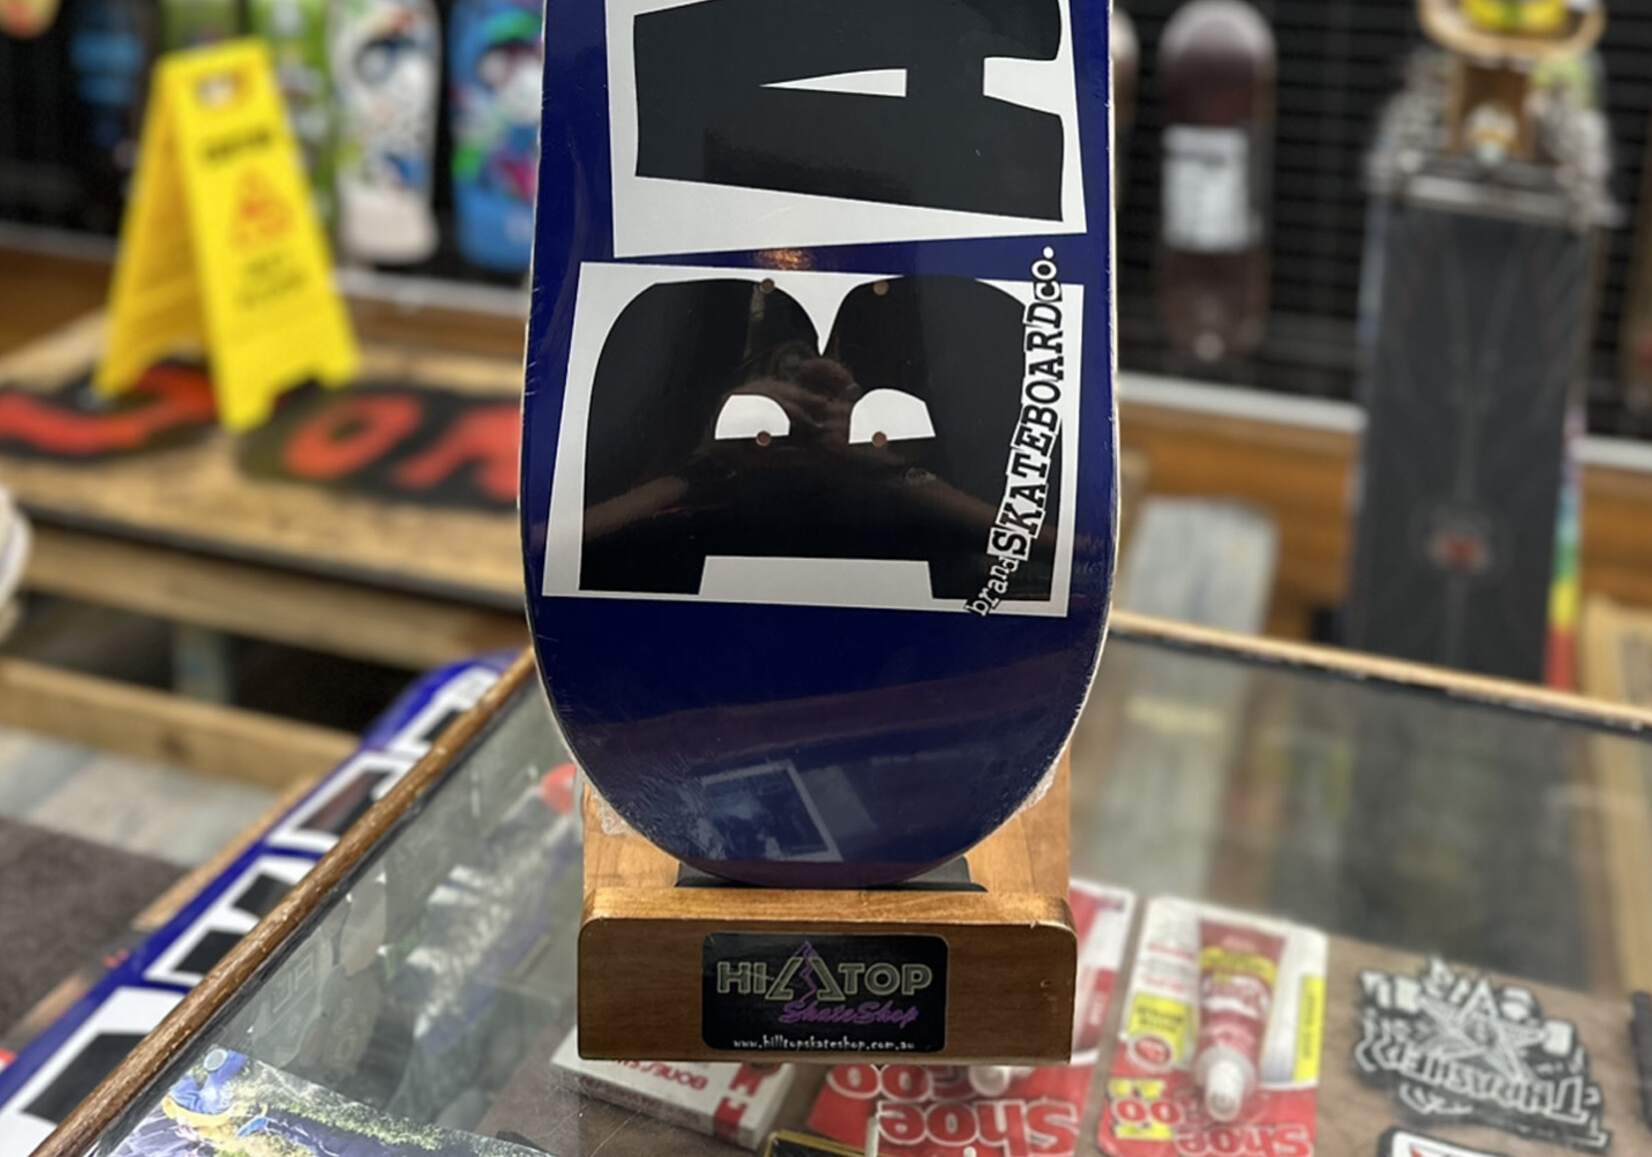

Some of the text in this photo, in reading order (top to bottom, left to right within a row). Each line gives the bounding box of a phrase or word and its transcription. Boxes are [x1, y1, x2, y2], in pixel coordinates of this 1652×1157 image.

[964, 555, 1018, 616] brand
[991, 301, 1064, 558] SKATEBOARD
[733, 1035, 915, 1051] www.hilltopskateshop.com.au
[877, 1099, 1079, 1157] Shoe
